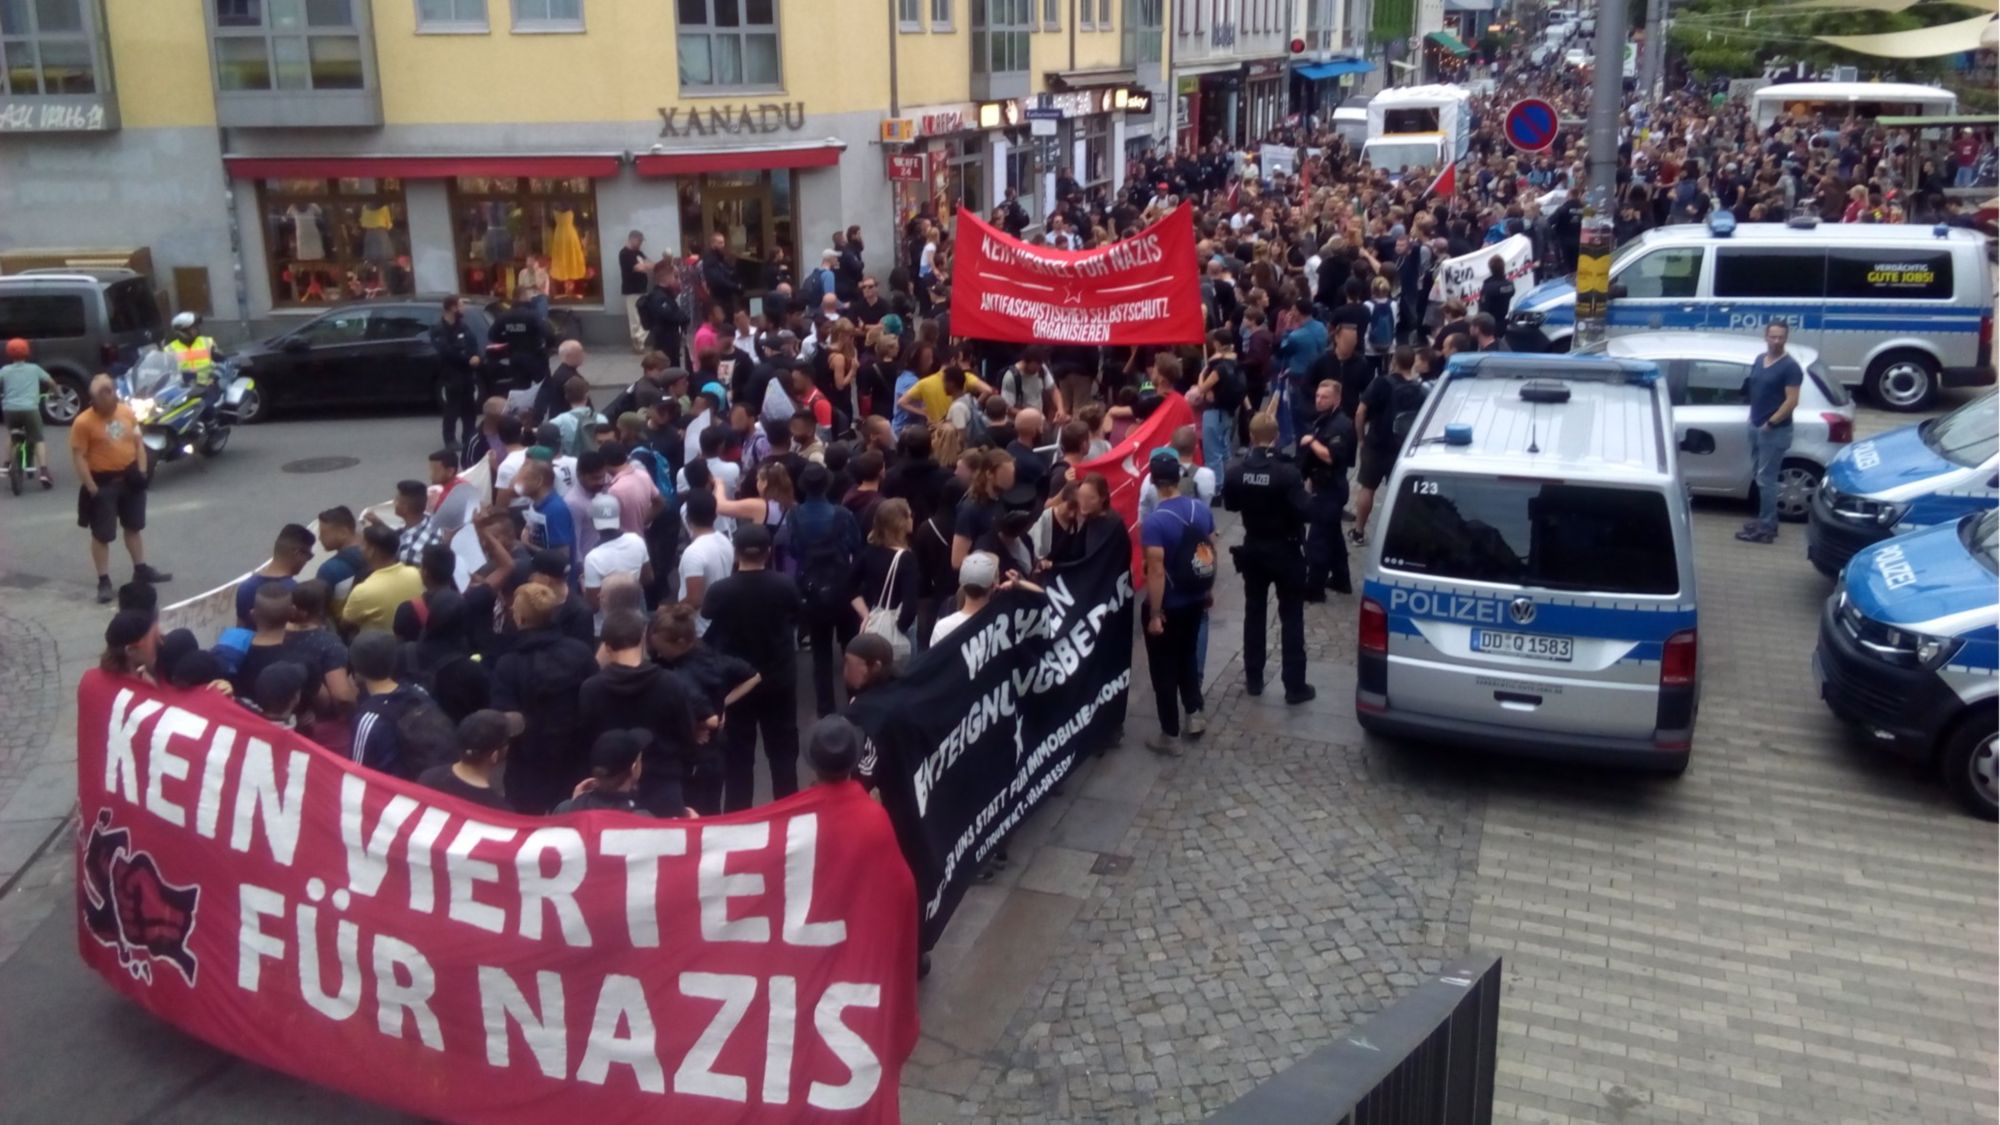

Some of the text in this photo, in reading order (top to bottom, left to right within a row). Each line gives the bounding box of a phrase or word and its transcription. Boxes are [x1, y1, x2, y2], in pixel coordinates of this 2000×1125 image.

[1127, 94, 1149, 110] sky
[657, 102, 805, 138] XANADU
[1108, 233, 1163, 273] NAZIS
[1866, 271, 1900, 283] GUTE
[979, 291, 1171, 325] ANTIFASCHISTISCHEN SELBSTSCHUTZ
[1032, 319, 1112, 342] ORGANISIEREN
[1242, 472, 1271, 486] POLIZEI
[1413, 481, 1438, 495] 123
[1390, 588, 1503, 624] POLIZEI
[961, 613, 1013, 681] WIR
[1481, 632, 1570, 656] DD Q 1583
[103, 686, 848, 950] KEIN VIERTEL
[975, 787, 1007, 836] STATT
[236, 875, 882, 1112] FÜR NAZIS
